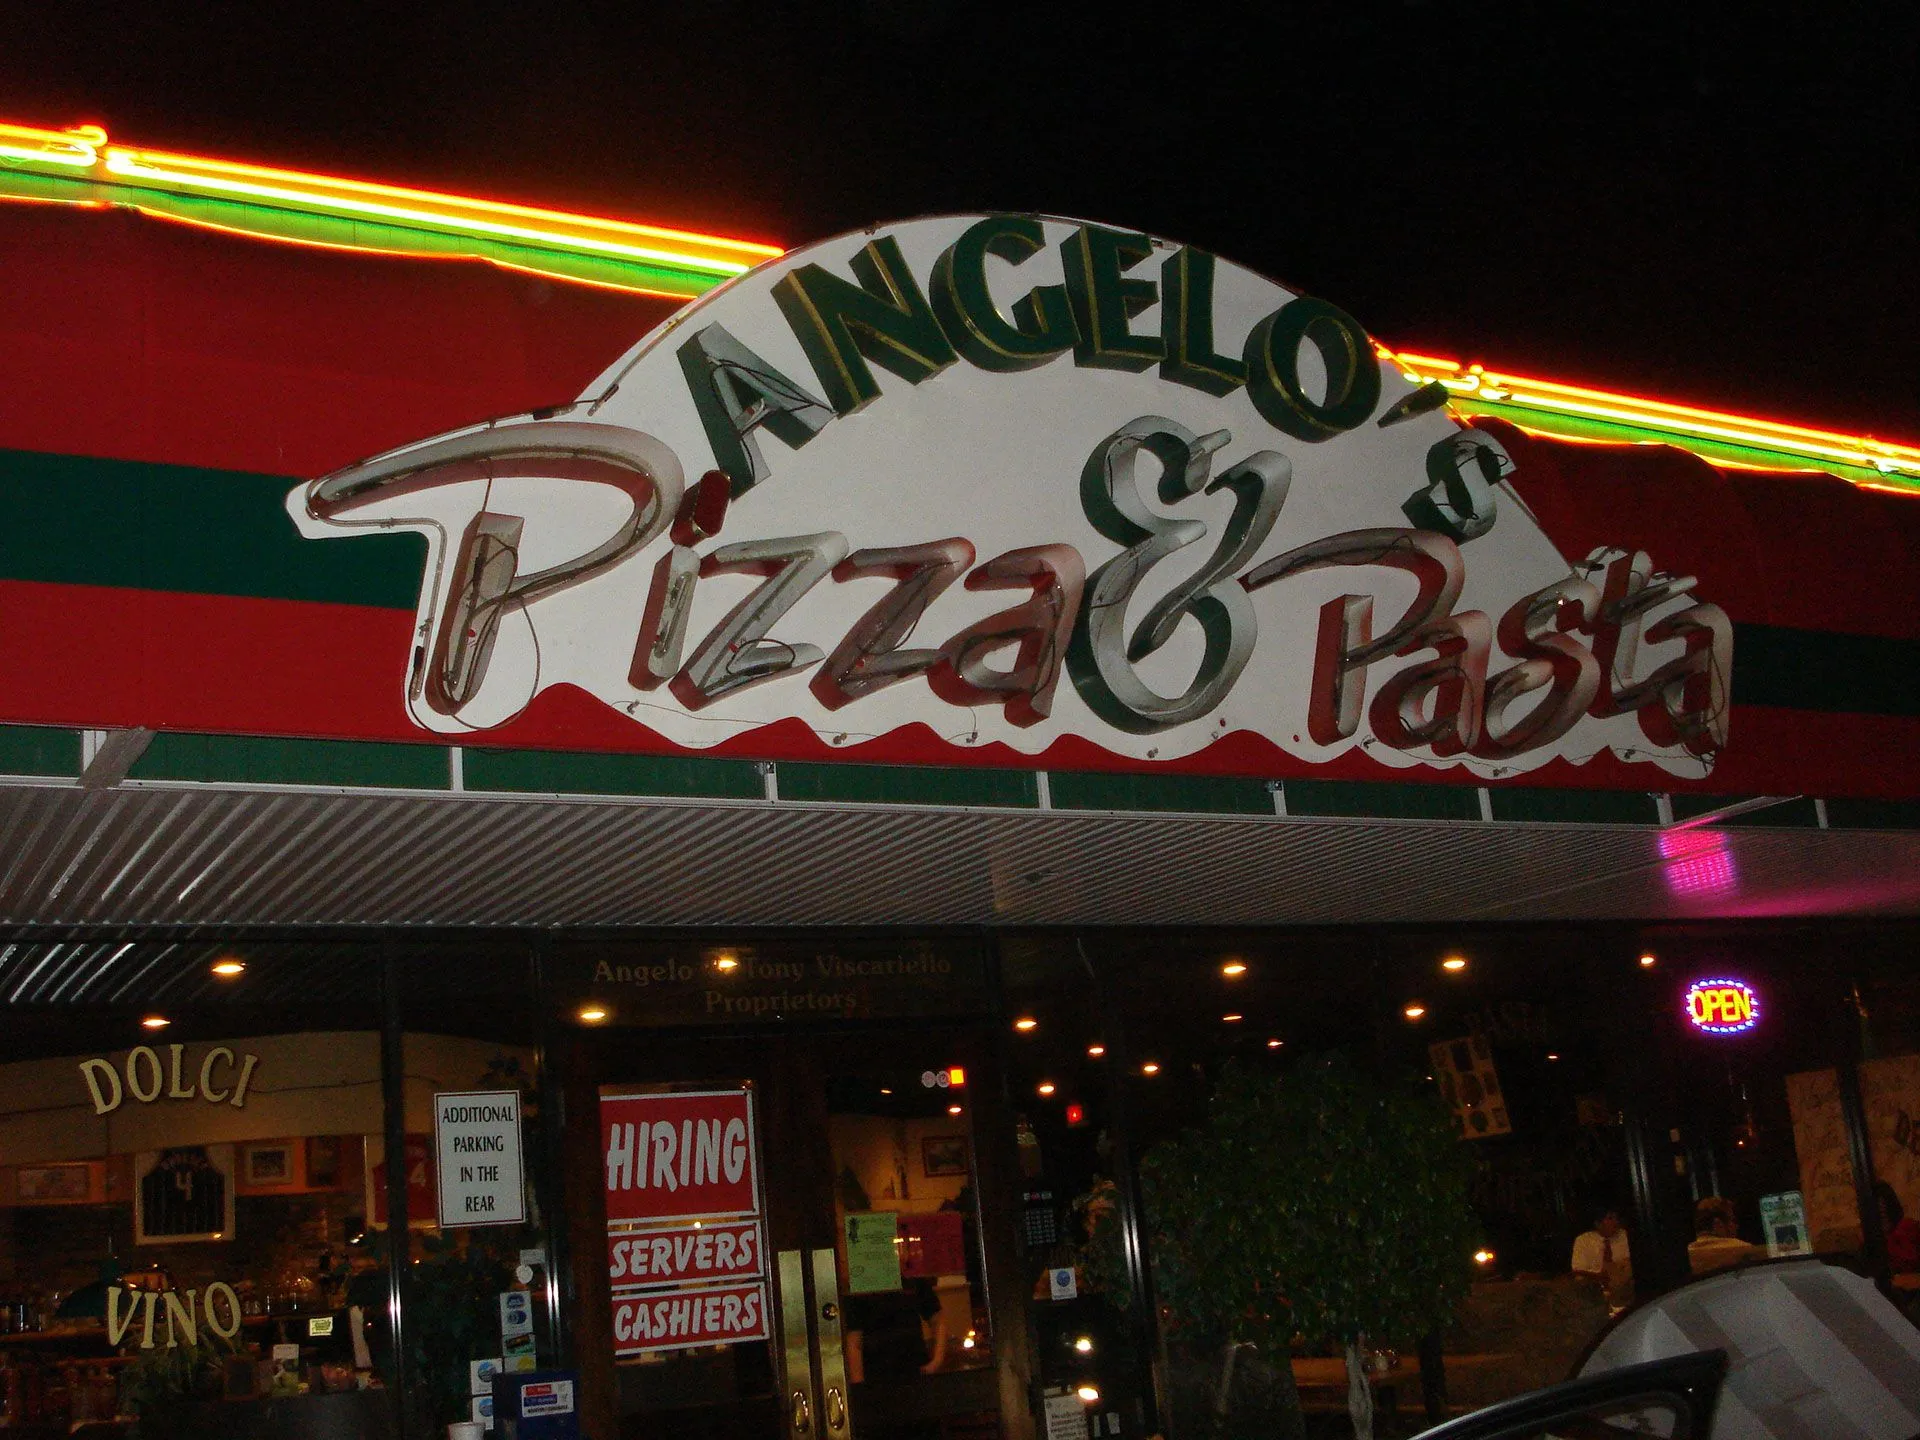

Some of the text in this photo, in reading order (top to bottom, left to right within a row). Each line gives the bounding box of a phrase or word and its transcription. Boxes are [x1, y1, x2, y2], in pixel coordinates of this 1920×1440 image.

[676, 214, 1517, 545] ANGELO'S
[306, 415, 1734, 764] Pizza & Pasta
[593, 959, 694, 988] Angelo
[816, 952, 952, 977] Viscariello
[704, 988, 857, 1017] Proprietors
[1690, 988, 1751, 1023] OPEN
[79, 1043, 258, 1115] DOLCI
[442, 1105, 514, 1123] ADDITIONAL
[453, 1135, 504, 1153] PARKING
[607, 1117, 747, 1192] HIRING
[460, 1165, 499, 1182] IN THE
[465, 1195, 495, 1212] REAR
[610, 1230, 755, 1278] SERVERS
[108, 1281, 242, 1349] VINO
[615, 1293, 760, 1341] CASHIERS
